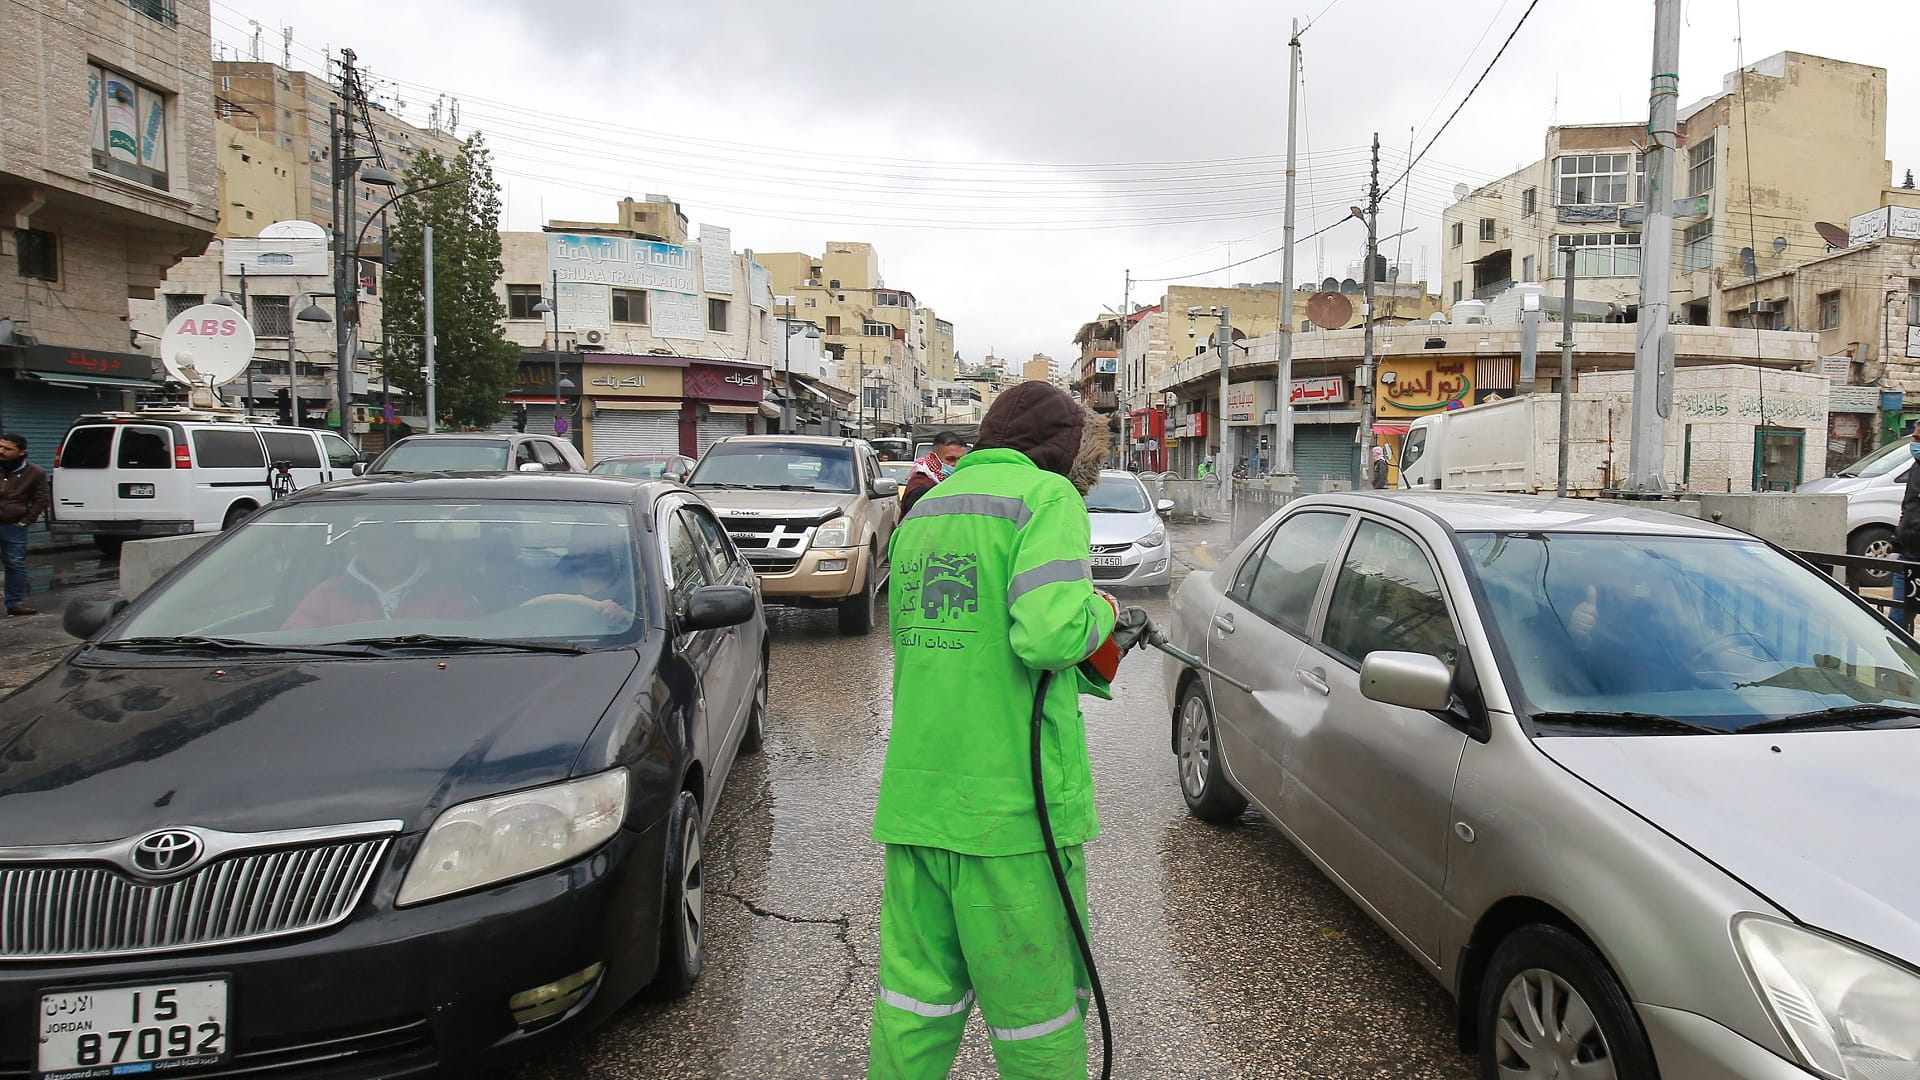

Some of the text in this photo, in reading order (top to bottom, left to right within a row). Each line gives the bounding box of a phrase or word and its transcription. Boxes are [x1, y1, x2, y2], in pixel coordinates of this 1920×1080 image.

[556, 239, 629, 266] للترجمة
[558, 266, 695, 291] SHUAA TRANSLATION
[177, 318, 237, 337] ABS
[591, 374, 646, 390] الكرنك
[724, 372, 758, 387] الكرنك
[1290, 381, 1341, 403] الرياض
[924, 636, 965, 650] خدمات
[46, 1021, 93, 1034] JORDAN
[77, 1022, 222, 1066] 87092
